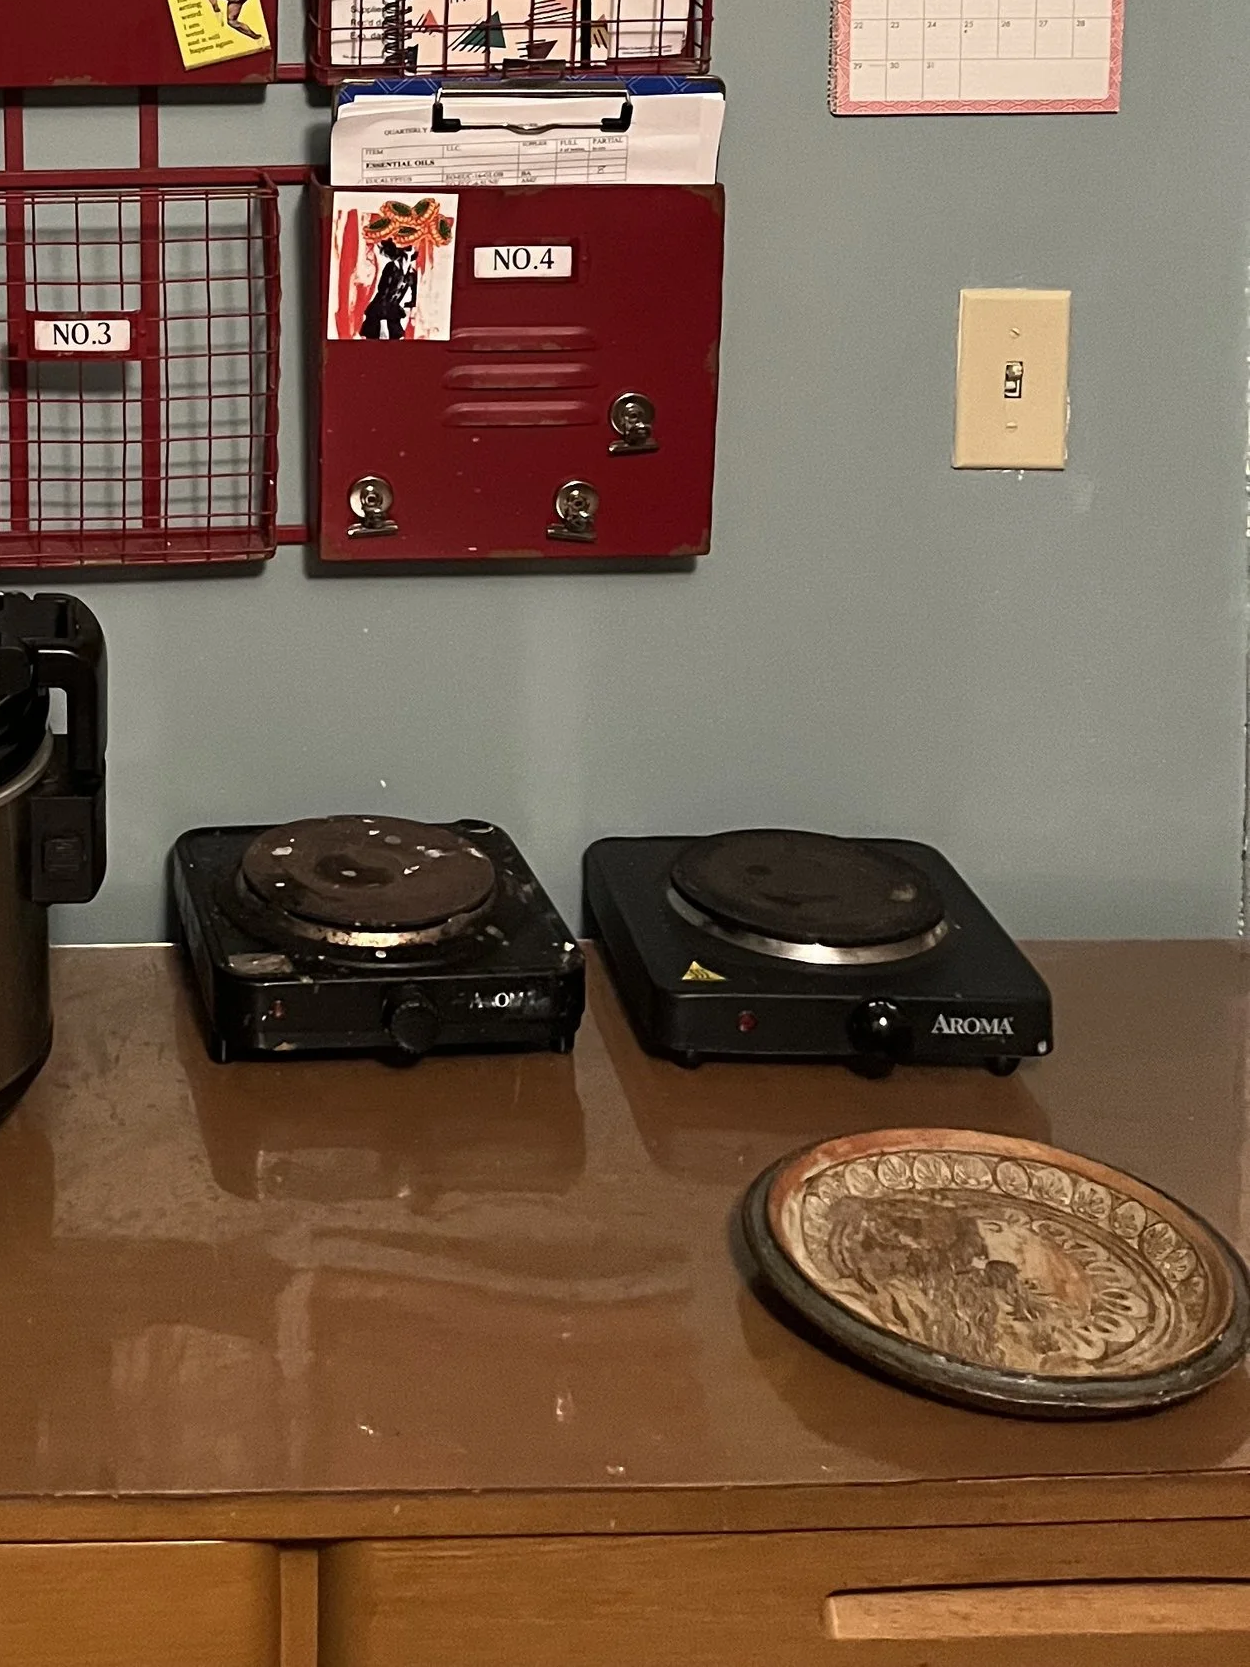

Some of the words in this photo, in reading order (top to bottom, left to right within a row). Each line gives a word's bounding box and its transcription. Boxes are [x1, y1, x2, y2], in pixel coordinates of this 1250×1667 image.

[592, 136, 623, 145] PARTIAL
[365, 161, 412, 169] ESSENTIAL
[414, 159, 435, 167] OILS
[493, 248, 555, 272] NO.4
[52, 321, 112, 346] NO.3
[930, 1013, 1015, 1035] AROMA
